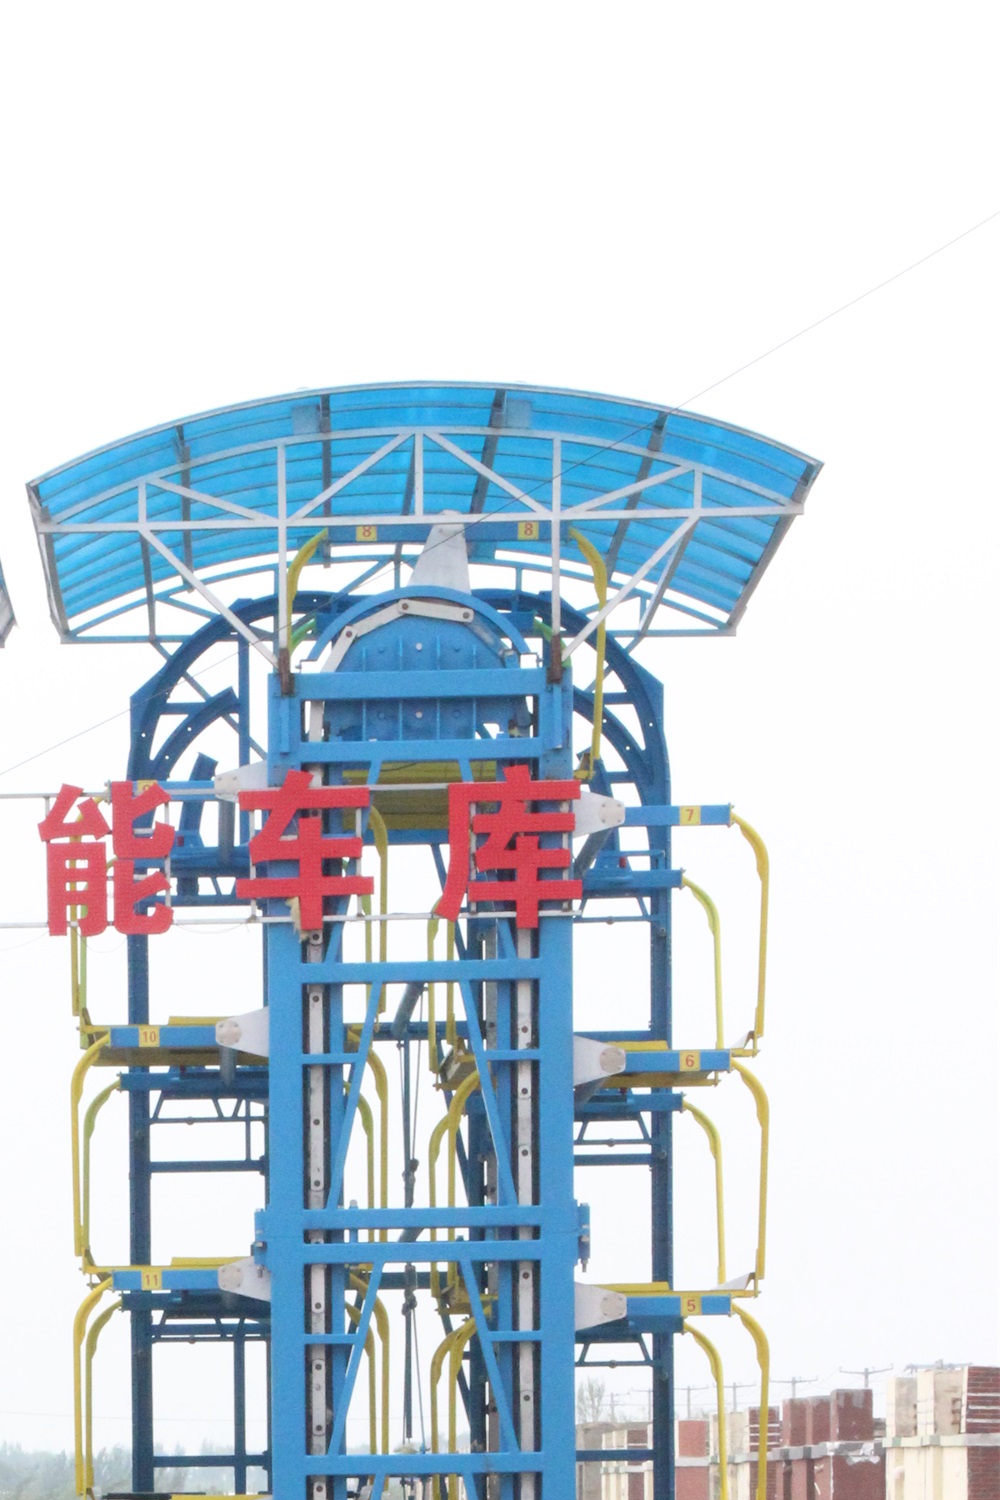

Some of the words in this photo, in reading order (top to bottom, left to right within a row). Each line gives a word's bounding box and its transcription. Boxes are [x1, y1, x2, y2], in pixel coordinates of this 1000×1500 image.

[361, 526, 372, 539] 8
[523, 522, 534, 537] 8
[685, 808, 695, 822] 7
[142, 1030, 157, 1045] 10
[684, 1053, 695, 1068] 6
[144, 1272, 158, 1286] 11
[686, 1298, 696, 1312] 5
